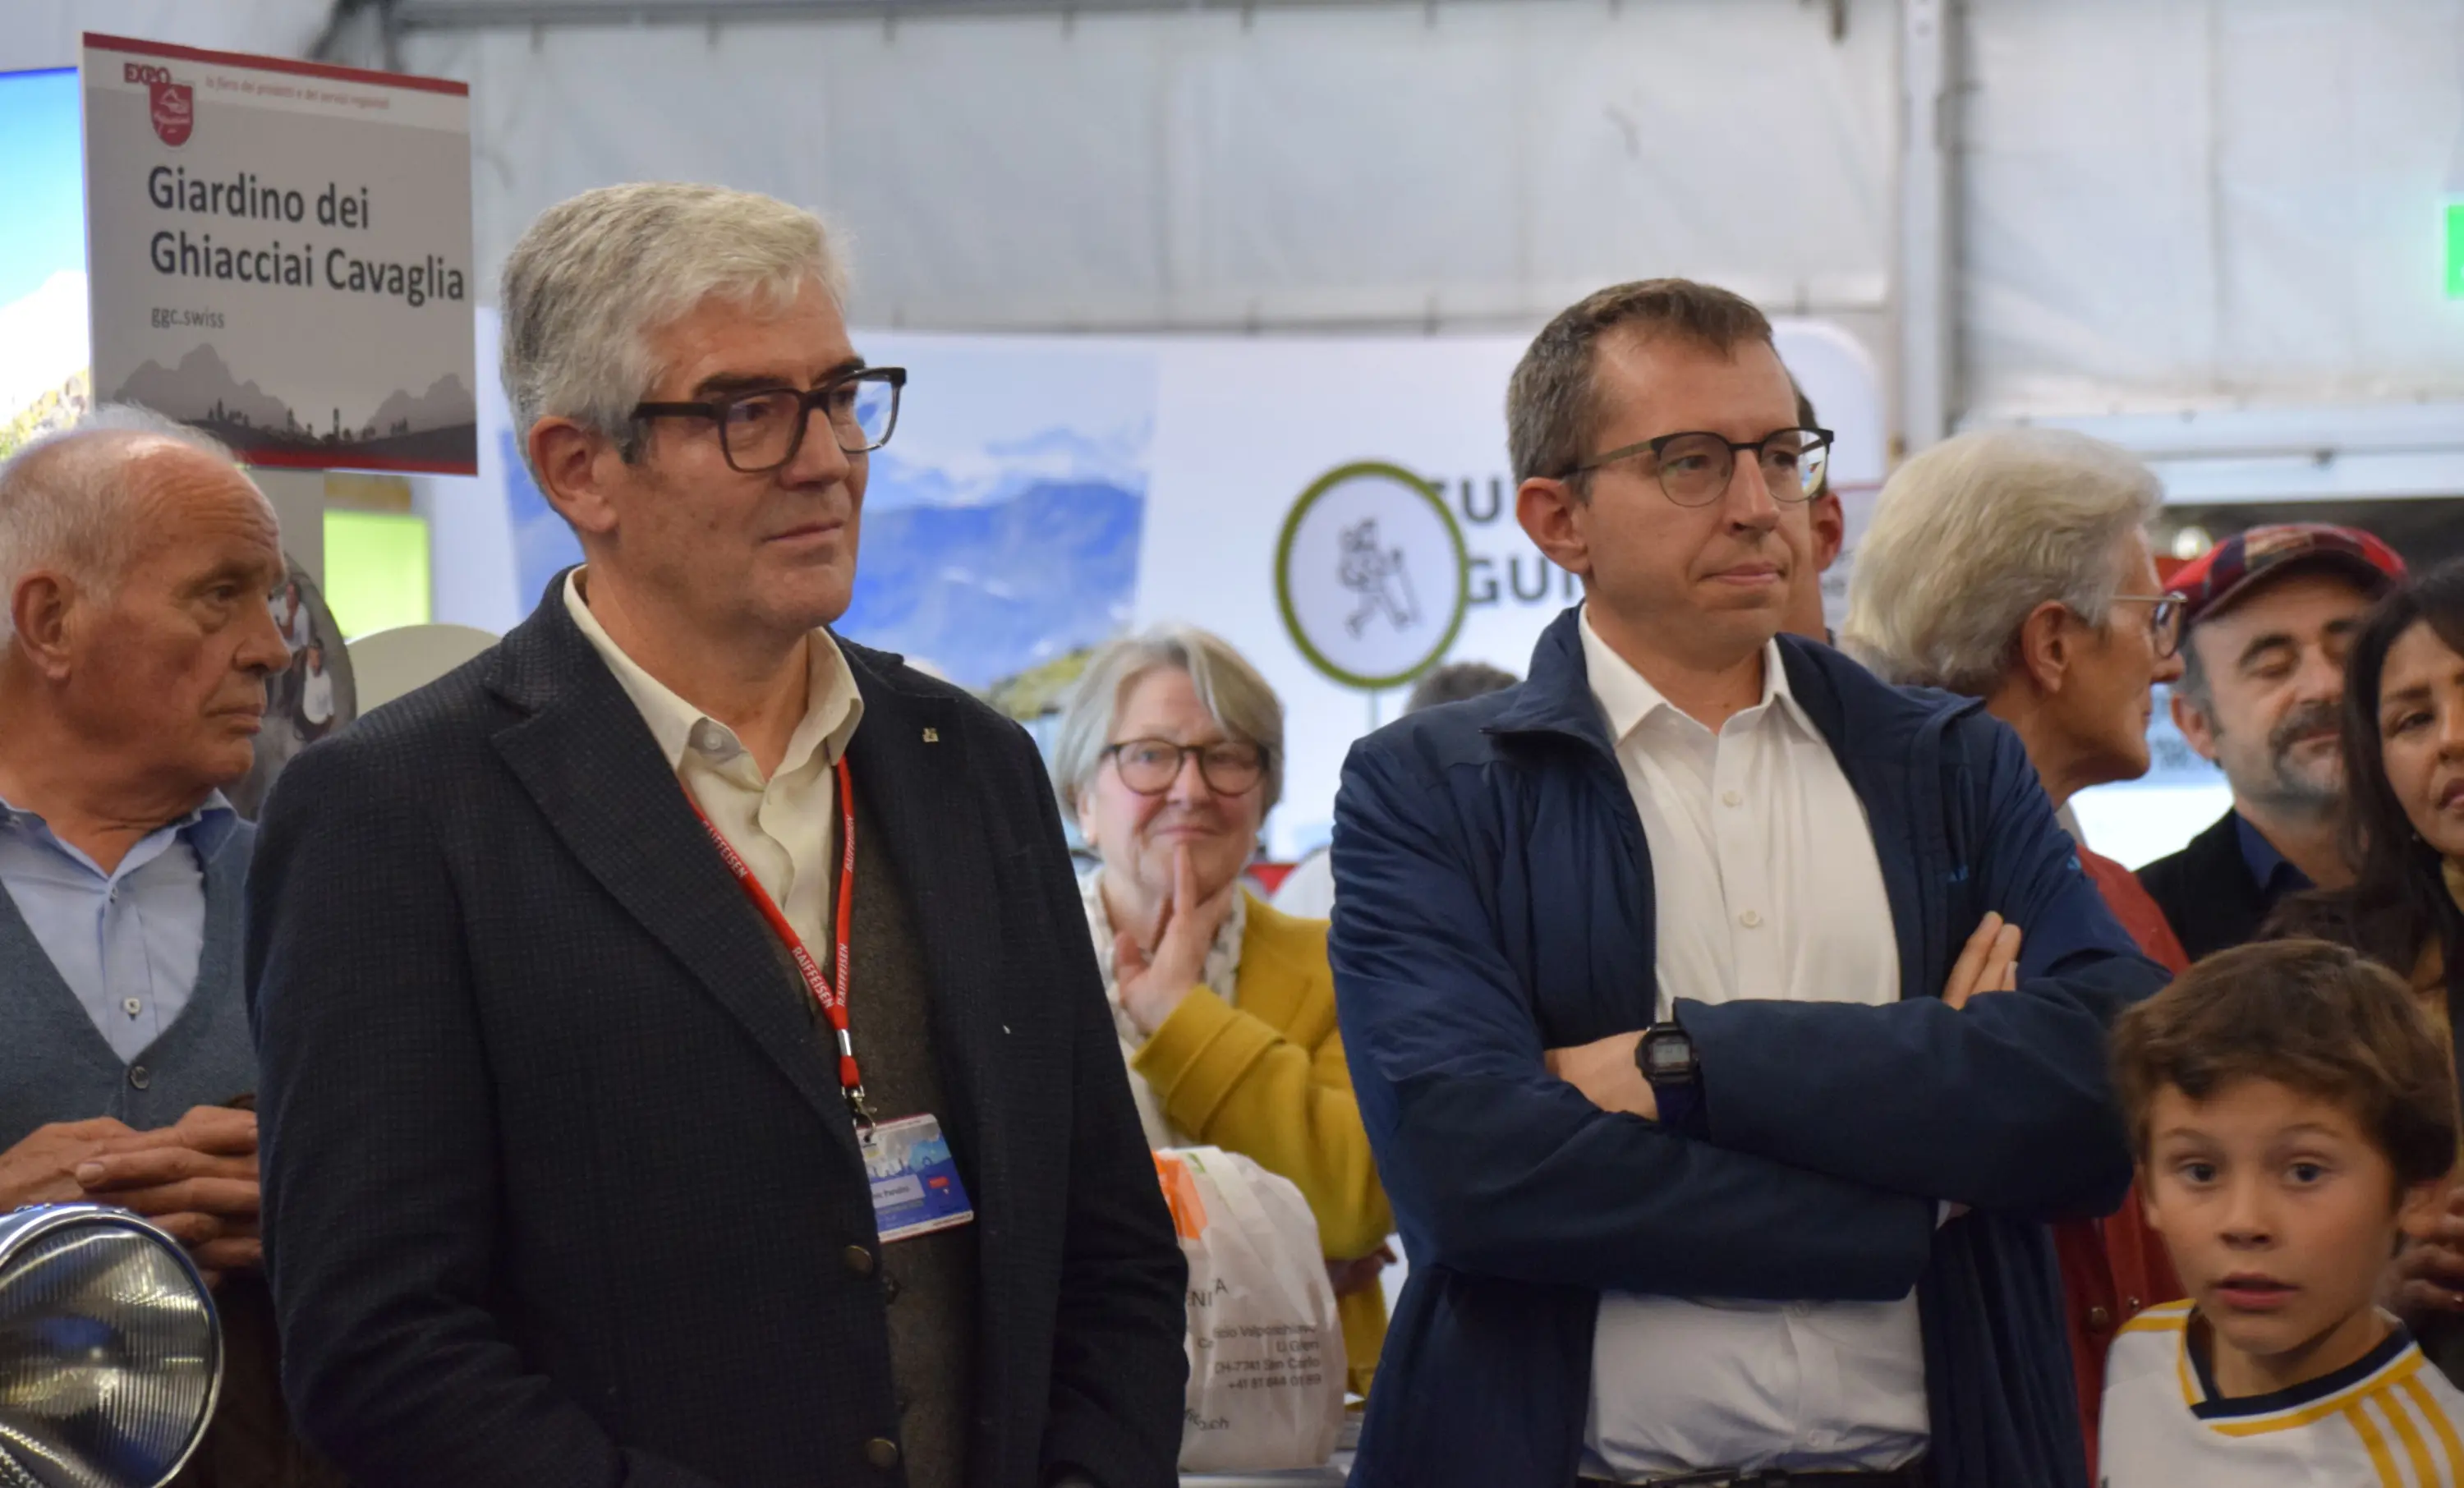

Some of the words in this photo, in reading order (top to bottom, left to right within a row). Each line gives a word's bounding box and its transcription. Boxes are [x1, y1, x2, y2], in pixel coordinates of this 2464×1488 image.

[148, 165, 305, 223] Giardino
[317, 183, 370, 229] dei
[150, 231, 313, 287] Ghiacciai
[325, 248, 465, 307] Cavaglia
[151, 307, 225, 329] ggc.swiss
[792, 946, 834, 1009] RAIFFEISEN
[836, 942, 849, 1007] RAIFFEISEN
